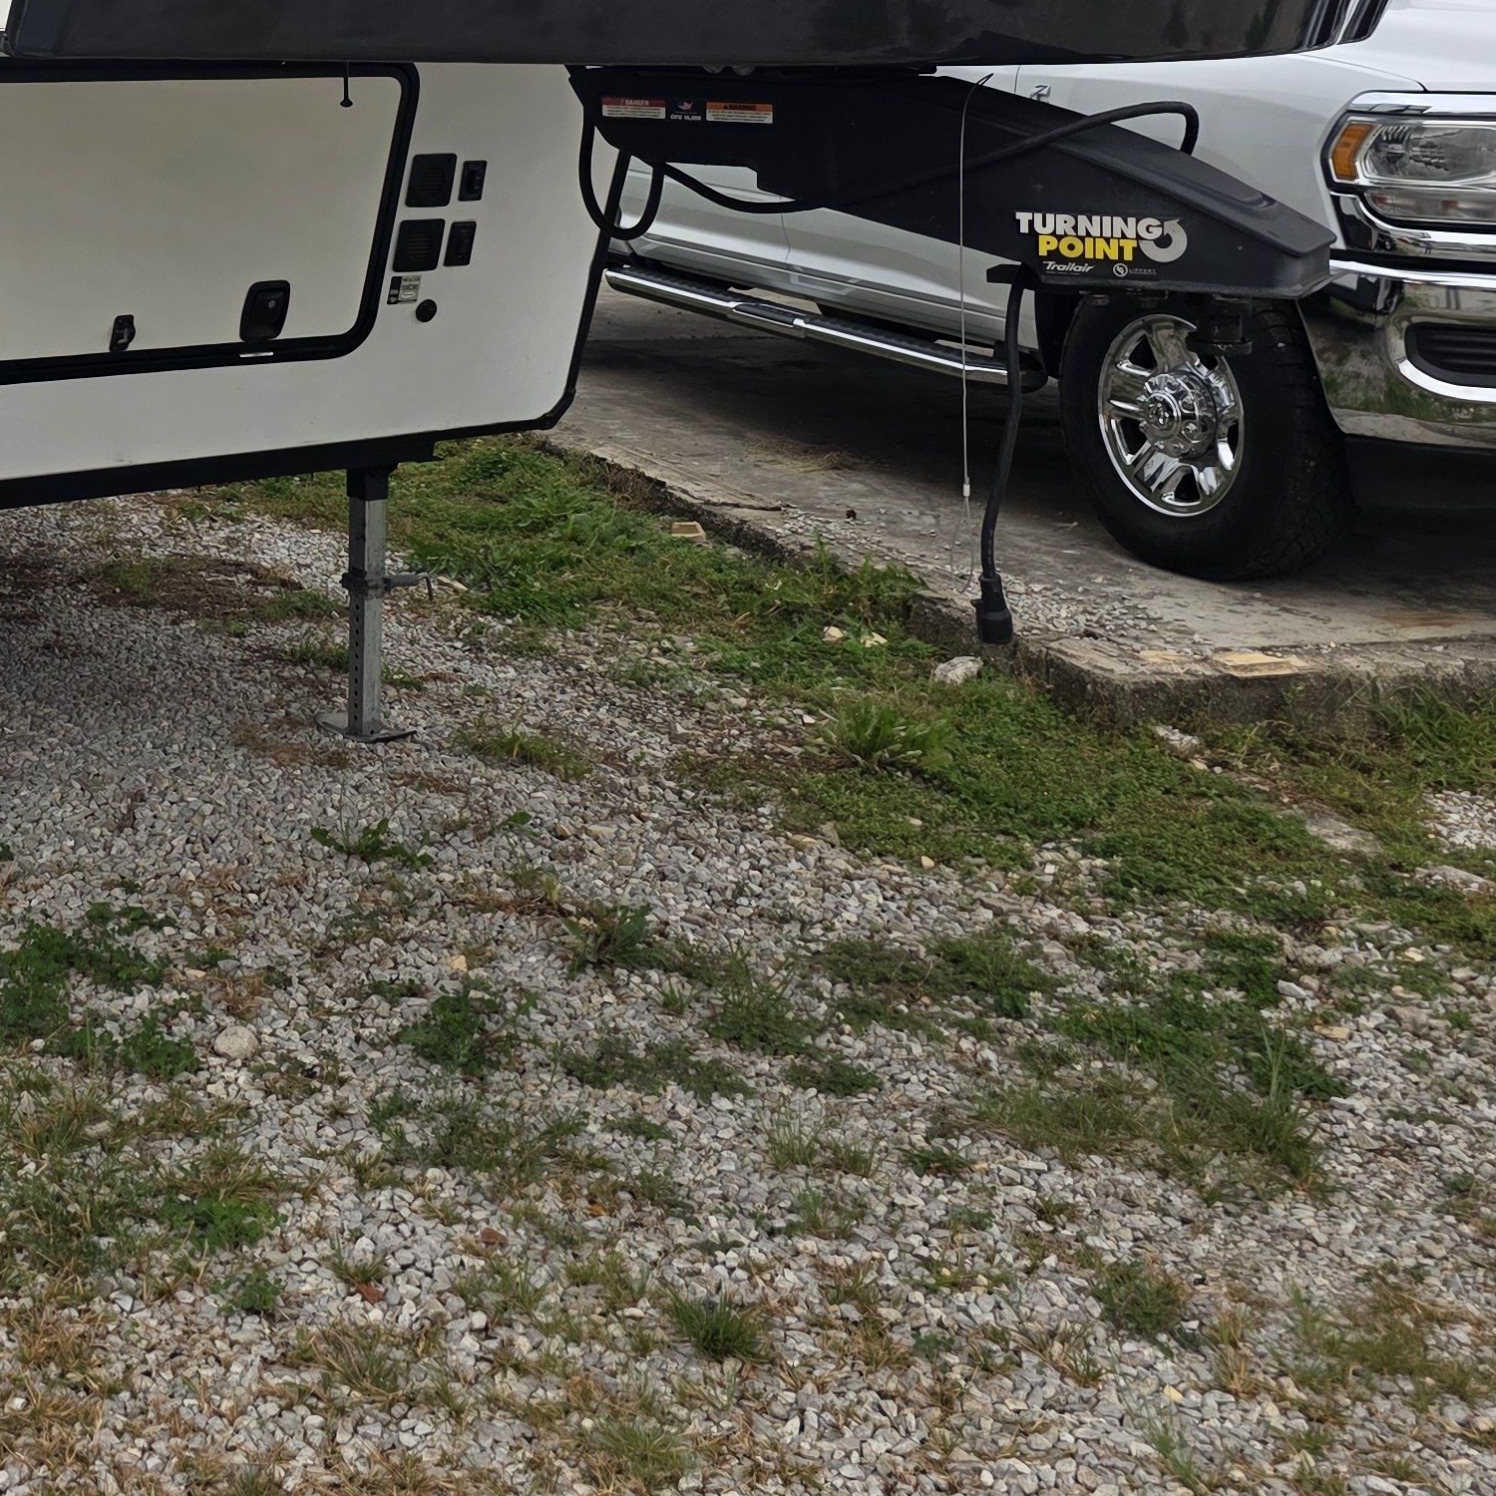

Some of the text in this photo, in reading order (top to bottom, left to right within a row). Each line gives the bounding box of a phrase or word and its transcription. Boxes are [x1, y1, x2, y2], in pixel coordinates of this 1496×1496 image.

[1015, 211, 1163, 241] TURNING
[1038, 234, 1138, 261] POINT
[1043, 261, 1095, 273] Trailair
